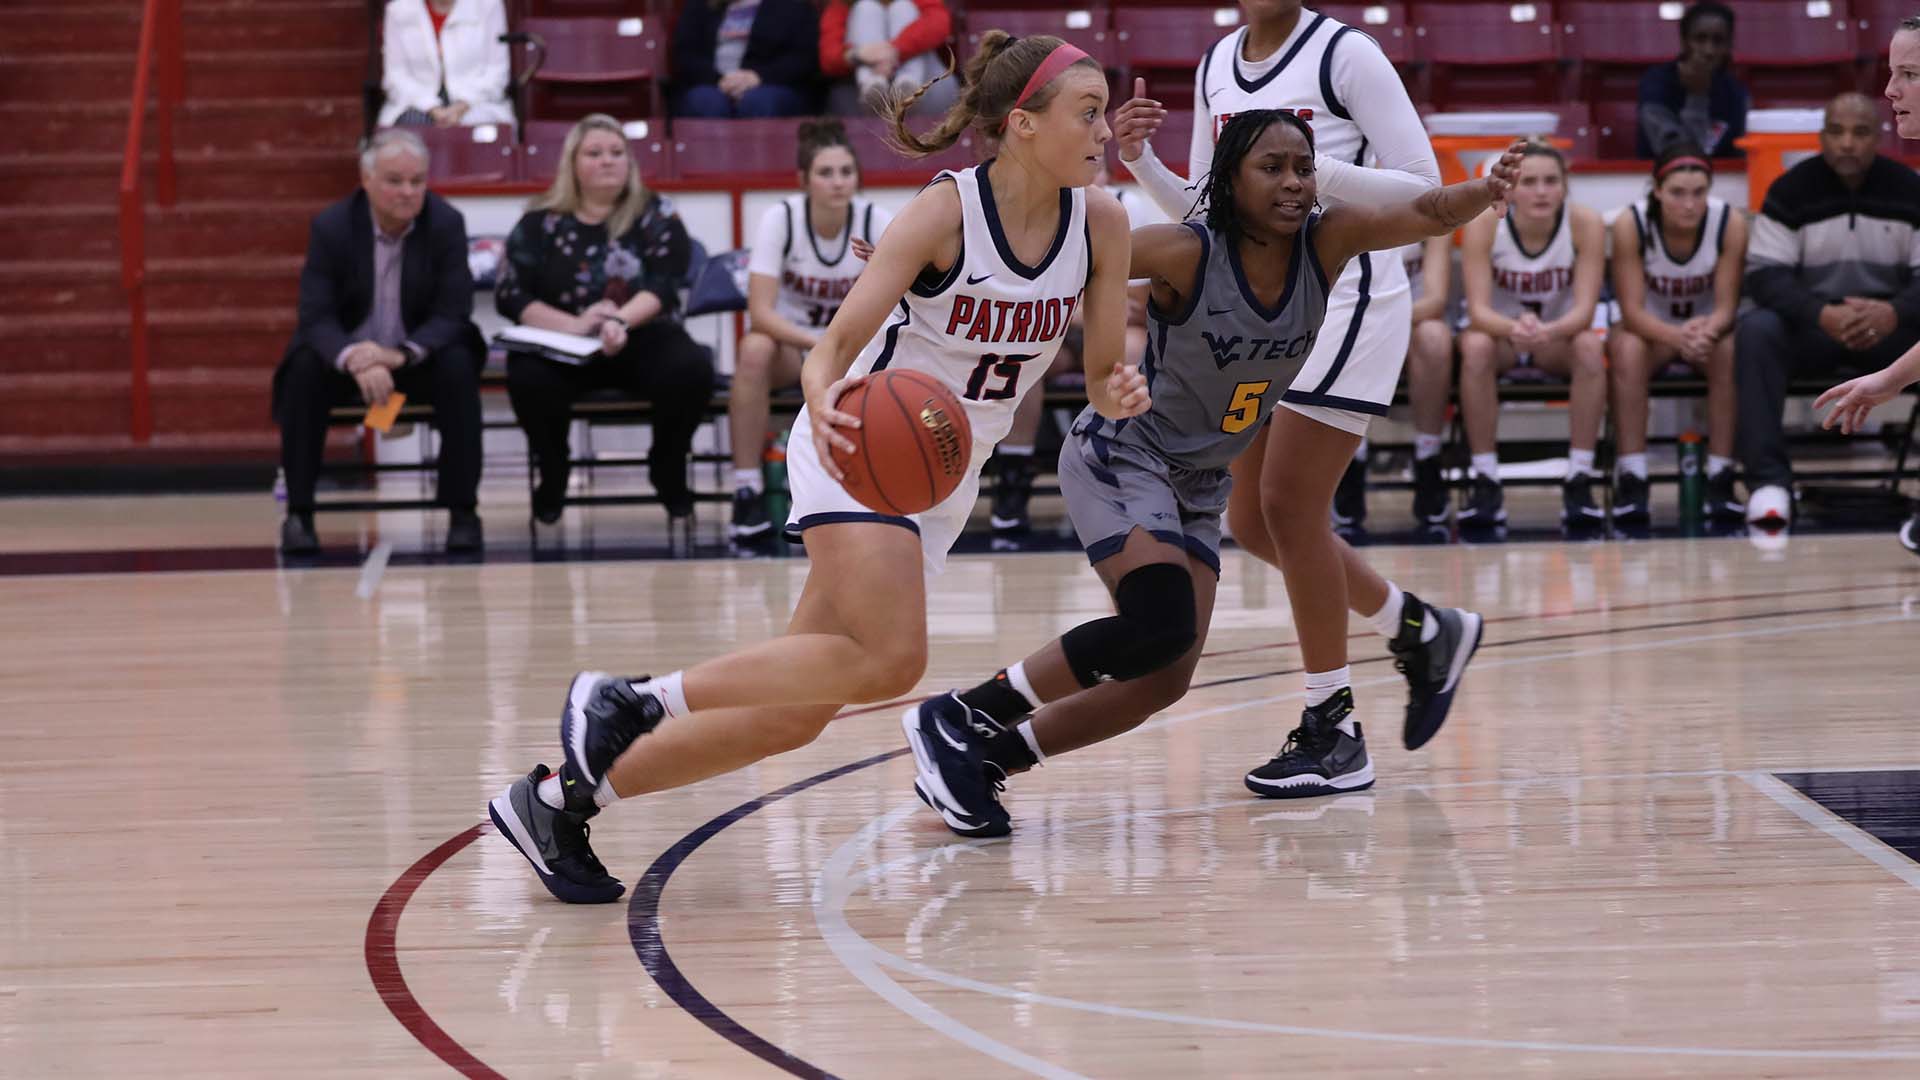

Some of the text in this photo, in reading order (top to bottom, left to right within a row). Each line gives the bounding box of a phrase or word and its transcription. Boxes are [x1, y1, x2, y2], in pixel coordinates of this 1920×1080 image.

[946, 288, 1084, 343] PATRIOT
[963, 353, 1042, 401] 15
[1220, 379, 1273, 434] 5
